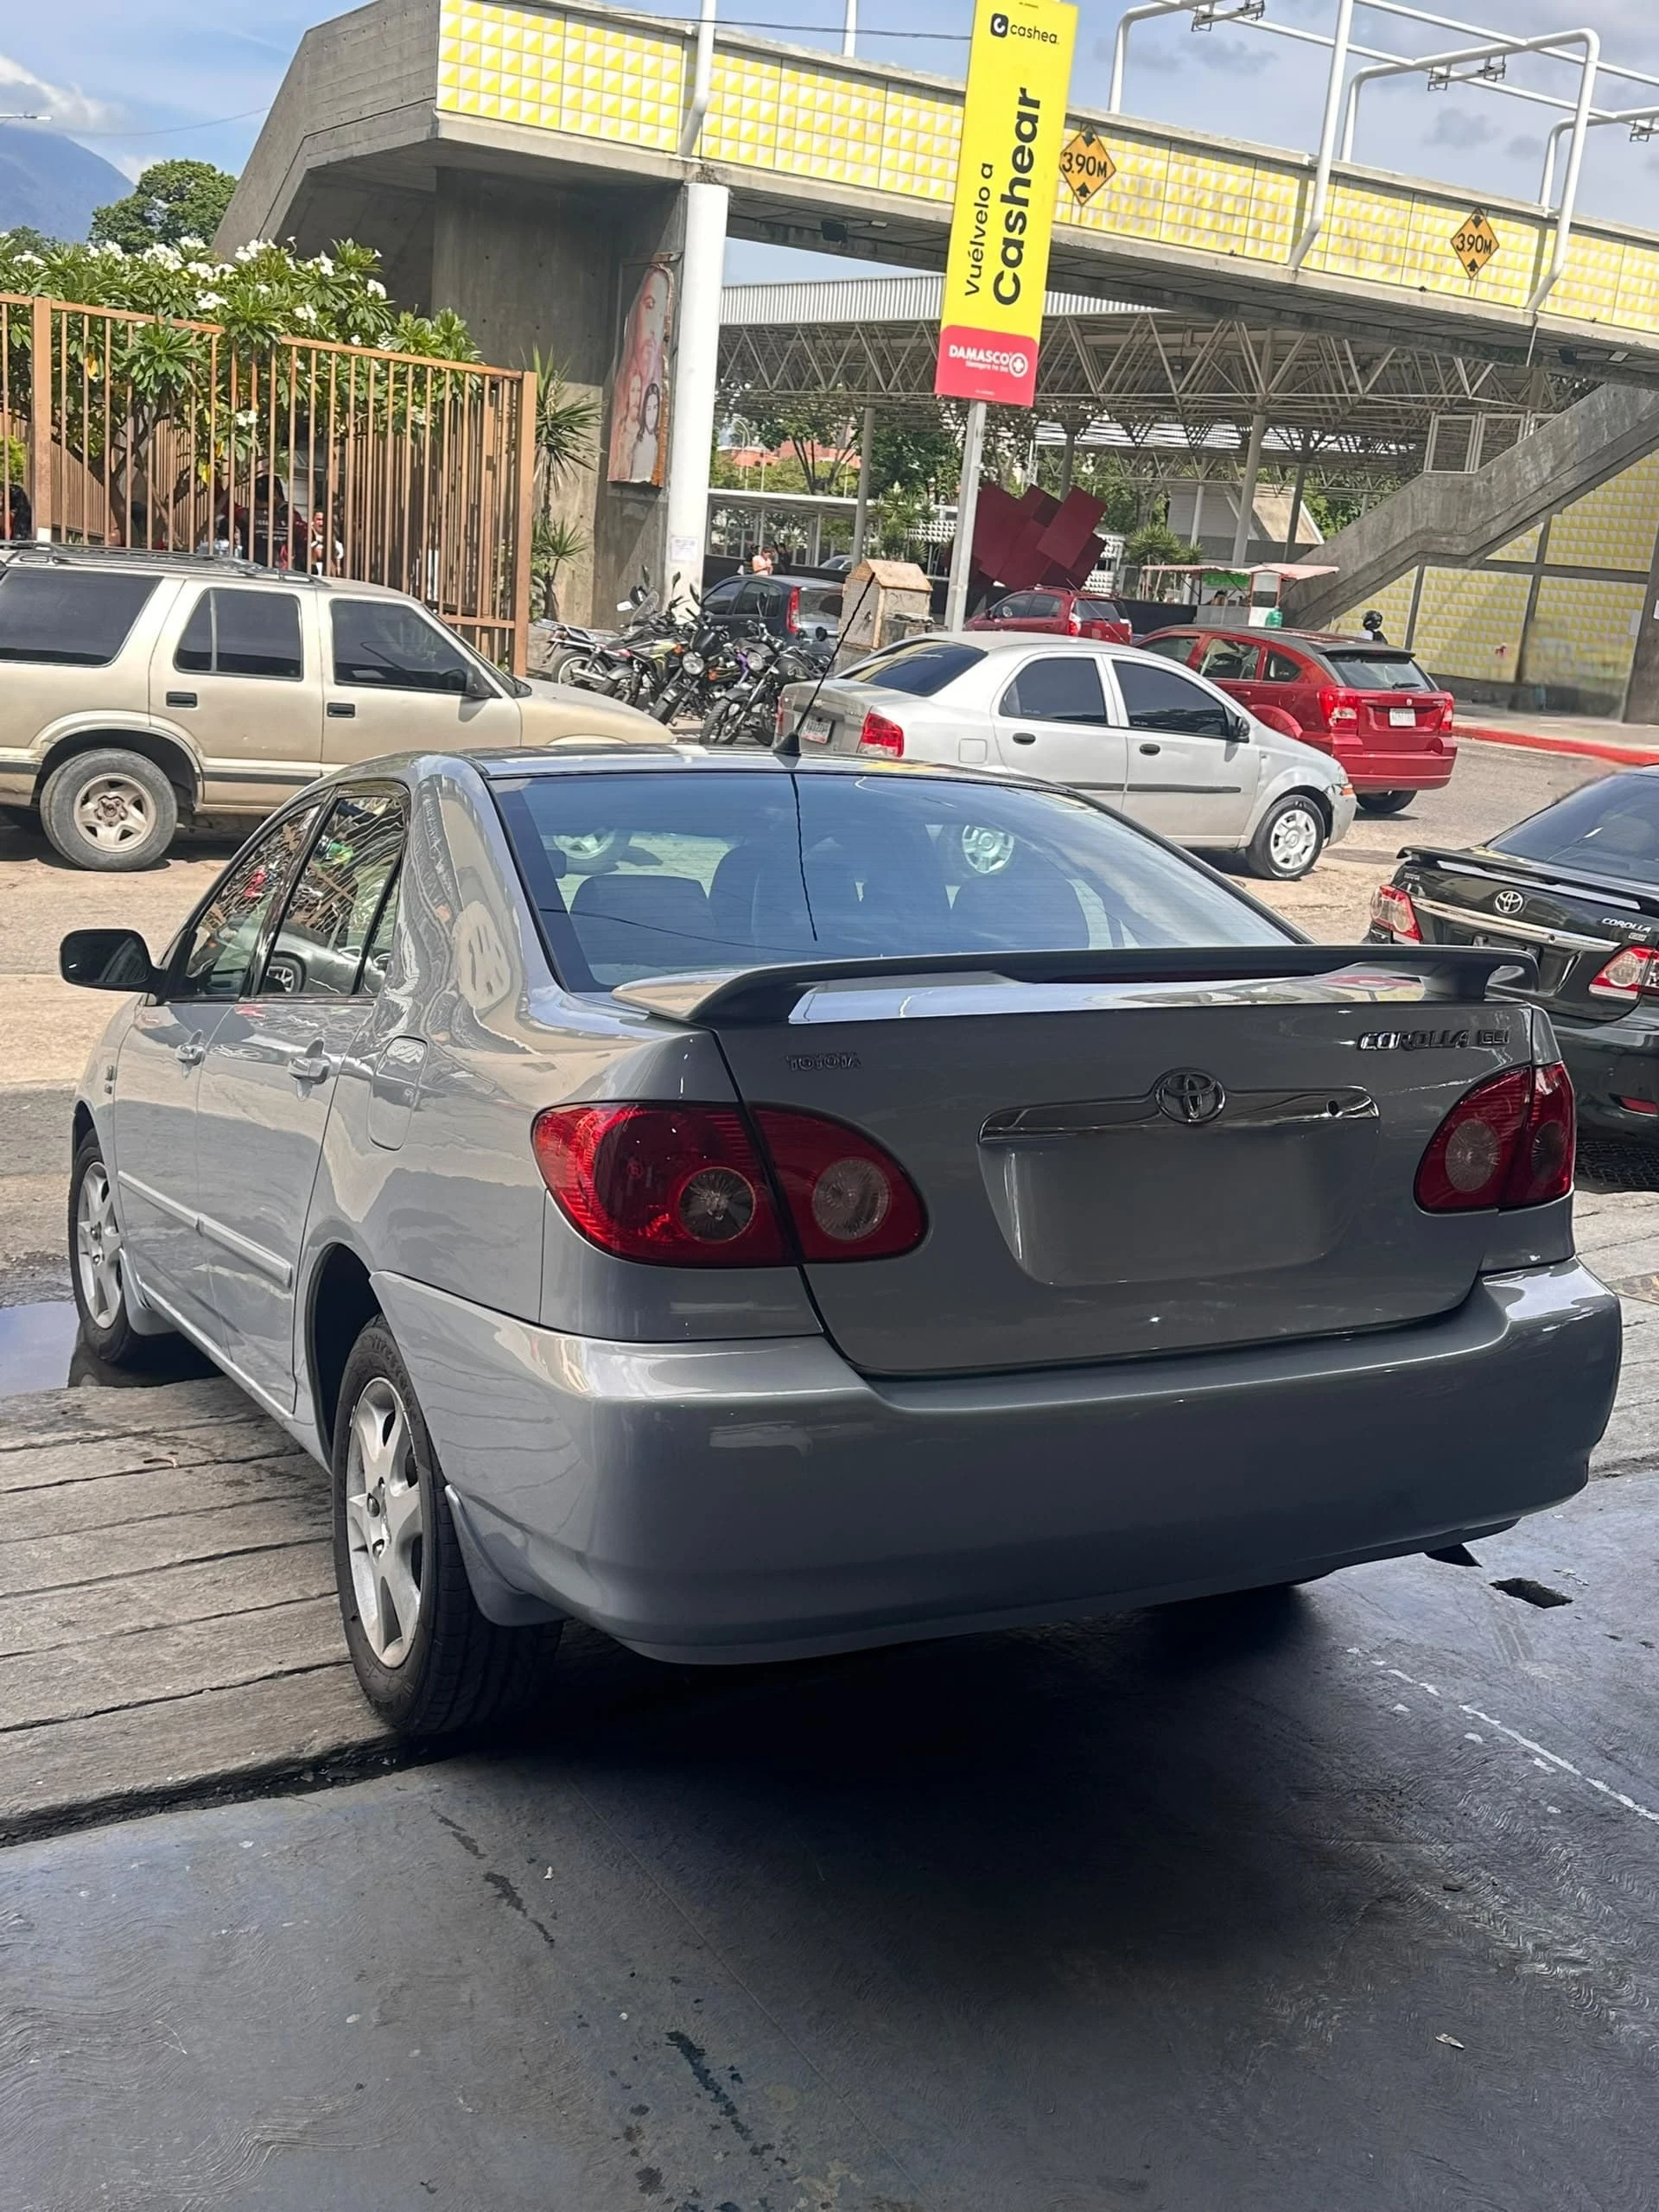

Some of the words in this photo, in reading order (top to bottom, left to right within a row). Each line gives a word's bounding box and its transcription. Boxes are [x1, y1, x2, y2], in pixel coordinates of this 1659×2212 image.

[1062, 152, 1107, 178] 3.90M
[993, 87, 1041, 306] Cashear
[964, 186, 991, 296] Vuélvelo
[981, 162, 994, 180] a
[949, 345, 1009, 365] DAMASCO
[1602, 918, 1652, 933] COROLLA
[1357, 1030, 1469, 1052] COROLLA
